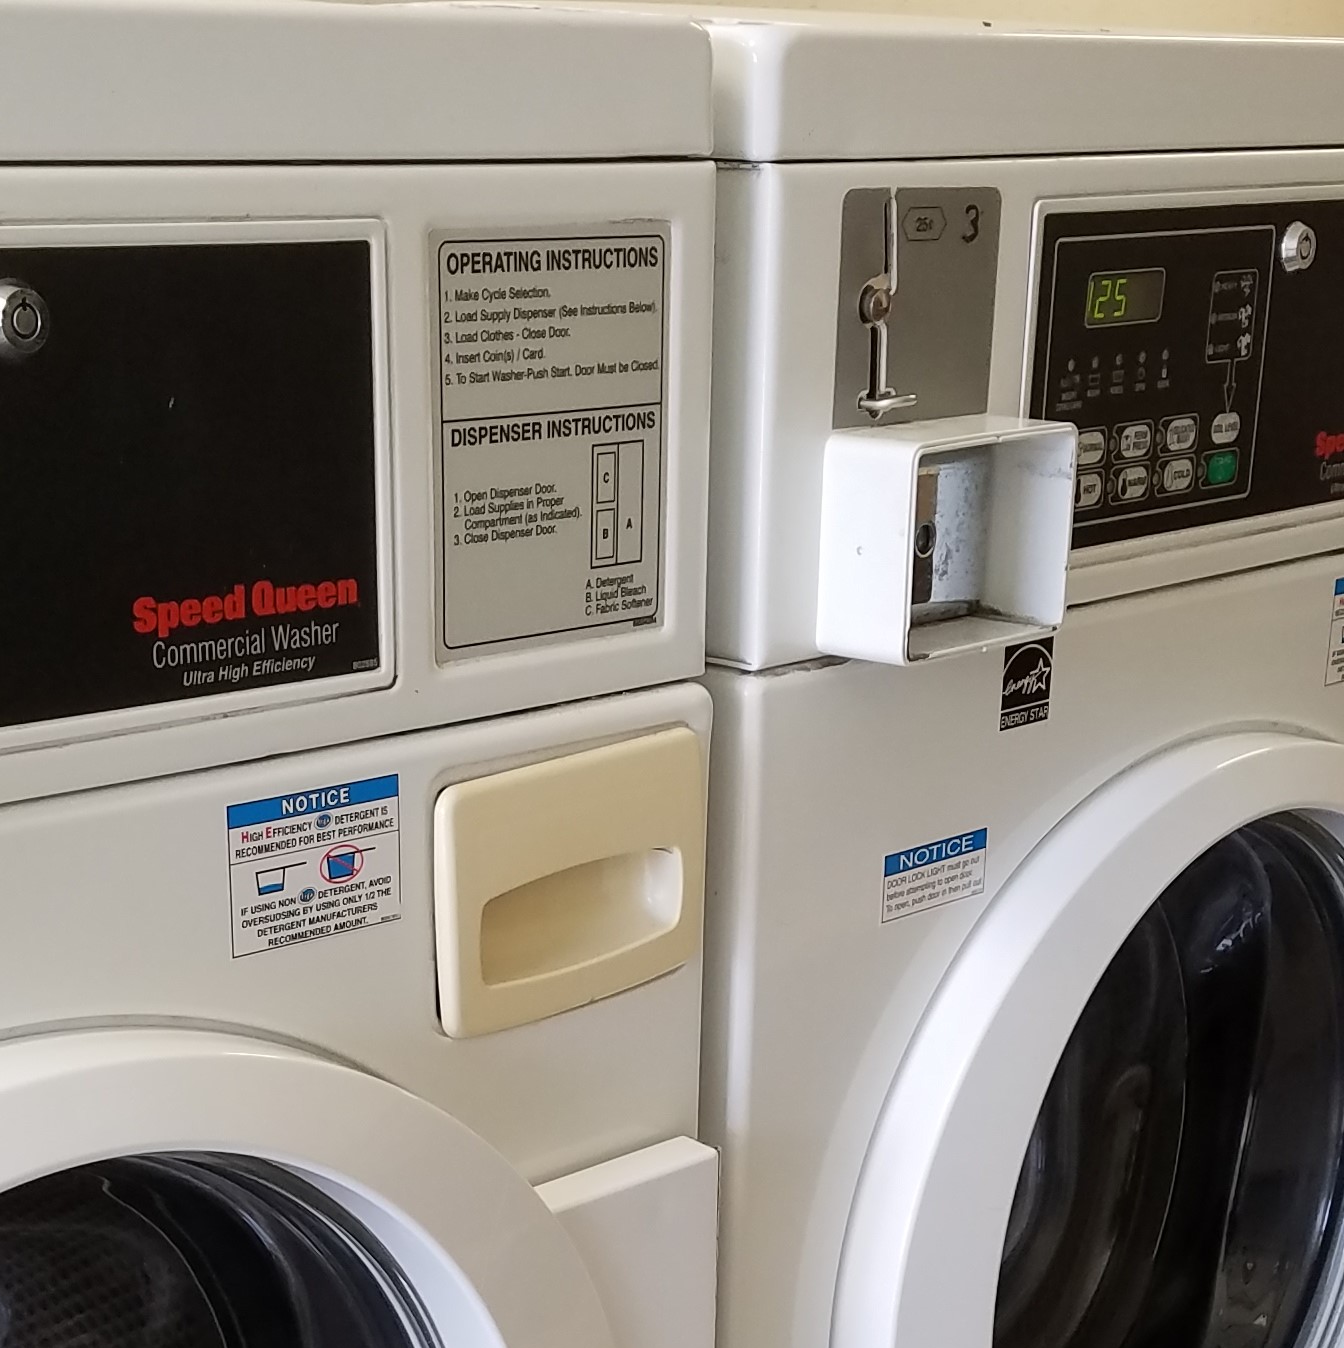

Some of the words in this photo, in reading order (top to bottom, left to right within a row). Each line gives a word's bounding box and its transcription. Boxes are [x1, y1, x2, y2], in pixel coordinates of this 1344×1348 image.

[962, 205, 979, 243] 3
[447, 250, 541, 274] OPERATING
[547, 246, 658, 271] INSTRUCTIONS
[455, 289, 479, 302] Make
[481, 289, 506, 303] Cycle
[509, 287, 550, 300] Selection.
[455, 311, 477, 322] Load
[481, 310, 511, 323] Supply
[514, 308, 556, 320] Dispenser
[581, 303, 626, 315] Instructions
[455, 332, 477, 343] Load
[481, 330, 514, 342] Clothes
[522, 328, 546, 339] Close
[456, 352, 480, 363] Insert
[483, 350, 514, 363] Coin(s)
[457, 374, 466, 384] To
[469, 372, 490, 383] Start
[492, 369, 548, 382] Washer-Push
[575, 365, 594, 376] Door
[598, 363, 616, 374] Must
[619, 363, 628, 372] be
[451, 422, 542, 447] DISPENSER
[547, 411, 655, 439] INSTRUCTIONS
[603, 472, 609, 483] C
[464, 491, 488, 502] Open
[490, 486, 532, 500] Dispenser
[464, 505, 485, 516] Load
[488, 502, 524, 515] Supplies
[527, 500, 534, 508] in
[537, 497, 564, 509] Proper
[464, 515, 523, 530] Compartment
[525, 512, 537, 525] (as
[626, 518, 633, 529] A
[464, 532, 489, 545] Close
[492, 529, 533, 543] Dispenser
[602, 528, 609, 539] B
[596, 574, 633, 589] Detergent
[596, 591, 618, 603] Liquid
[621, 585, 646, 597] Bleach
[132, 584, 245, 638] Speed
[252, 578, 358, 616] Queen
[596, 601, 620, 615] Fabric
[622, 597, 653, 610] Softener
[152, 628, 265, 668] Commercial
[271, 622, 340, 650] Washer
[182, 667, 214, 687] Ultra
[218, 664, 248, 684] High
[252, 656, 316, 676] Efficiency
[1001, 711, 1028, 728] ENERGY
[1030, 706, 1048, 720] STAR
[282, 788, 349, 815] NOTICE
[335, 808, 378, 825] DETERGENT
[381, 806, 388, 815] IS
[235, 836, 297, 858] RECOMMENDED
[299, 835, 314, 846] FOR
[317, 831, 335, 843] BEST
[338, 818, 394, 838] PERFORMANCE
[900, 835, 974, 870] NOTICE
[241, 908, 248, 916] IF
[251, 902, 276, 914] USING
[279, 898, 296, 908] NON
[369, 876, 392, 887] AVOID
[242, 908, 300, 928] OVERSUDSING
[303, 906, 313, 915] BY
[316, 899, 340, 912] USING
[343, 895, 362, 906] ONLY
[365, 893, 375, 901] 1/2
[377, 888, 392, 897] THE
[257, 921, 307, 938] DETERGENT
[309, 902, 378, 925] MANUFACTURERS
[268, 925, 331, 946] RECOMMENDED
[334, 918, 369, 931] AMOUNT.
